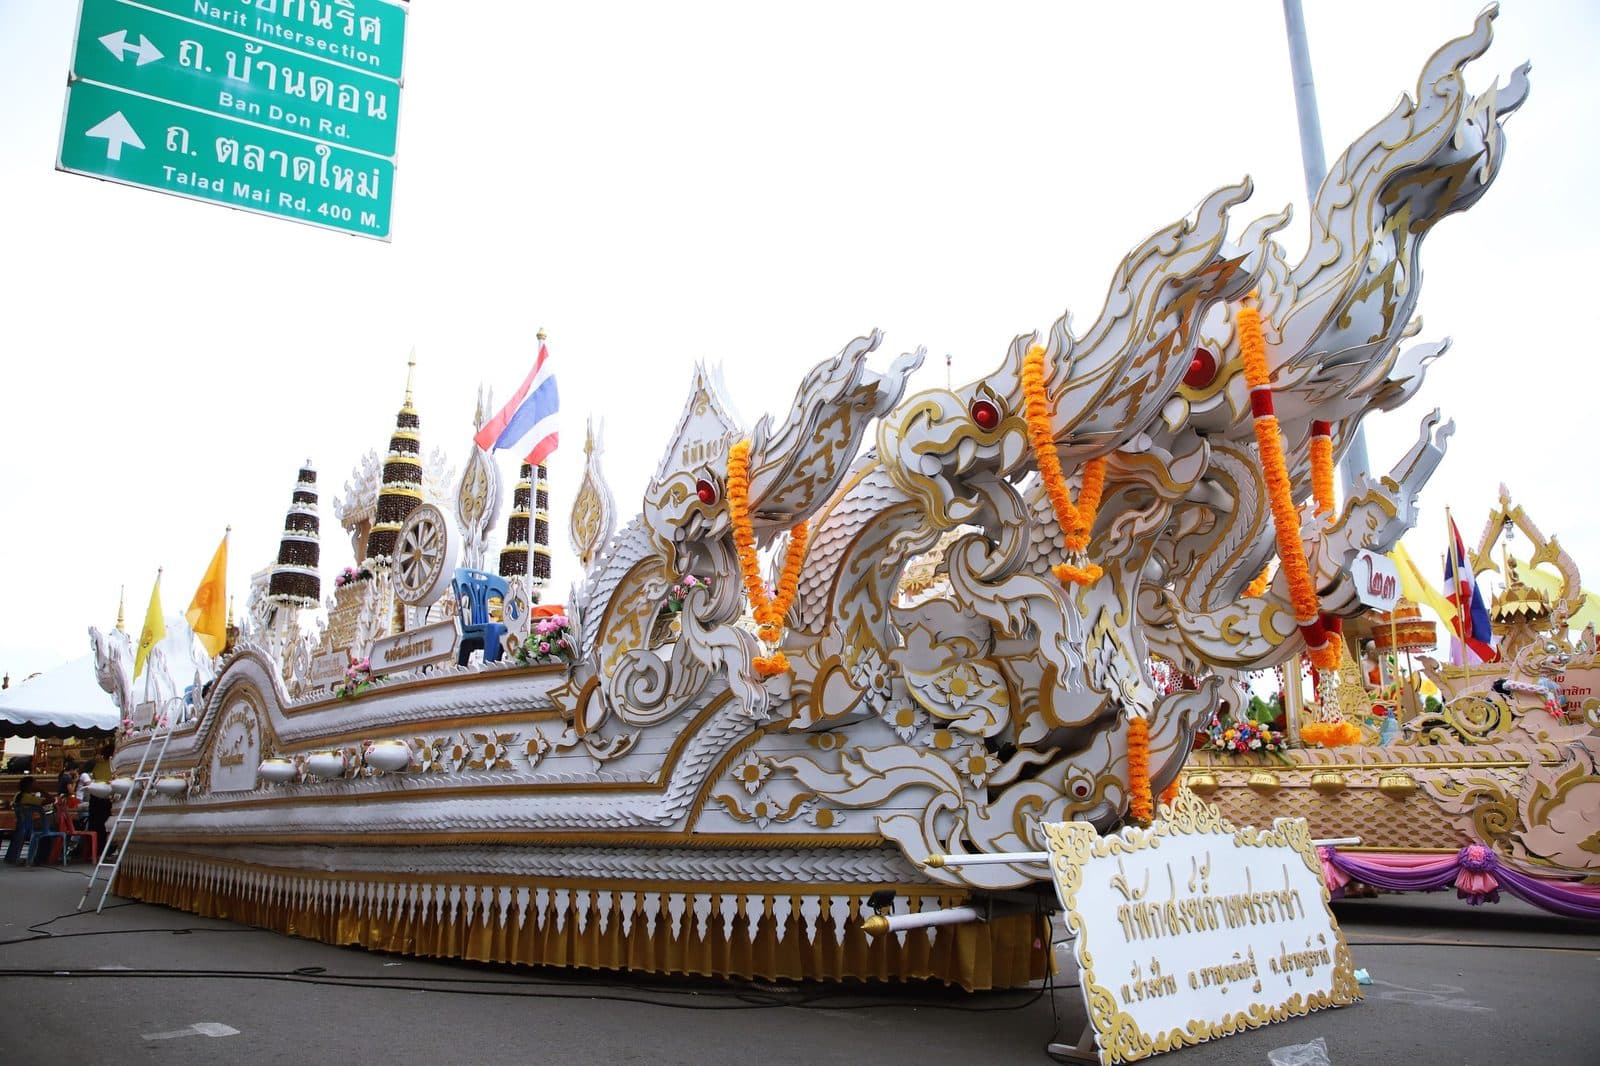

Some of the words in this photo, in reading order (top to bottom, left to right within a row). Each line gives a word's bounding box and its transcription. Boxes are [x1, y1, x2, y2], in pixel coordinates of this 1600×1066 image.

[193, 0, 246, 27] Narit
[256, 17, 381, 67] Intersection
[178, 39, 212, 73] ถ.
[225, 42, 388, 121] บ้านดอน
[218, 91, 260, 116] Ban
[269, 106, 311, 129] Don
[318, 118, 351, 139] Rd.
[162, 165, 225, 194] Talad
[231, 181, 272, 204] Mai
[278, 192, 311, 214] Rd.
[317, 202, 352, 223] 400
[360, 211, 381, 229] M.
[166, 126, 198, 156] ถ.
[214, 136, 379, 201] ตลาดใหม่
